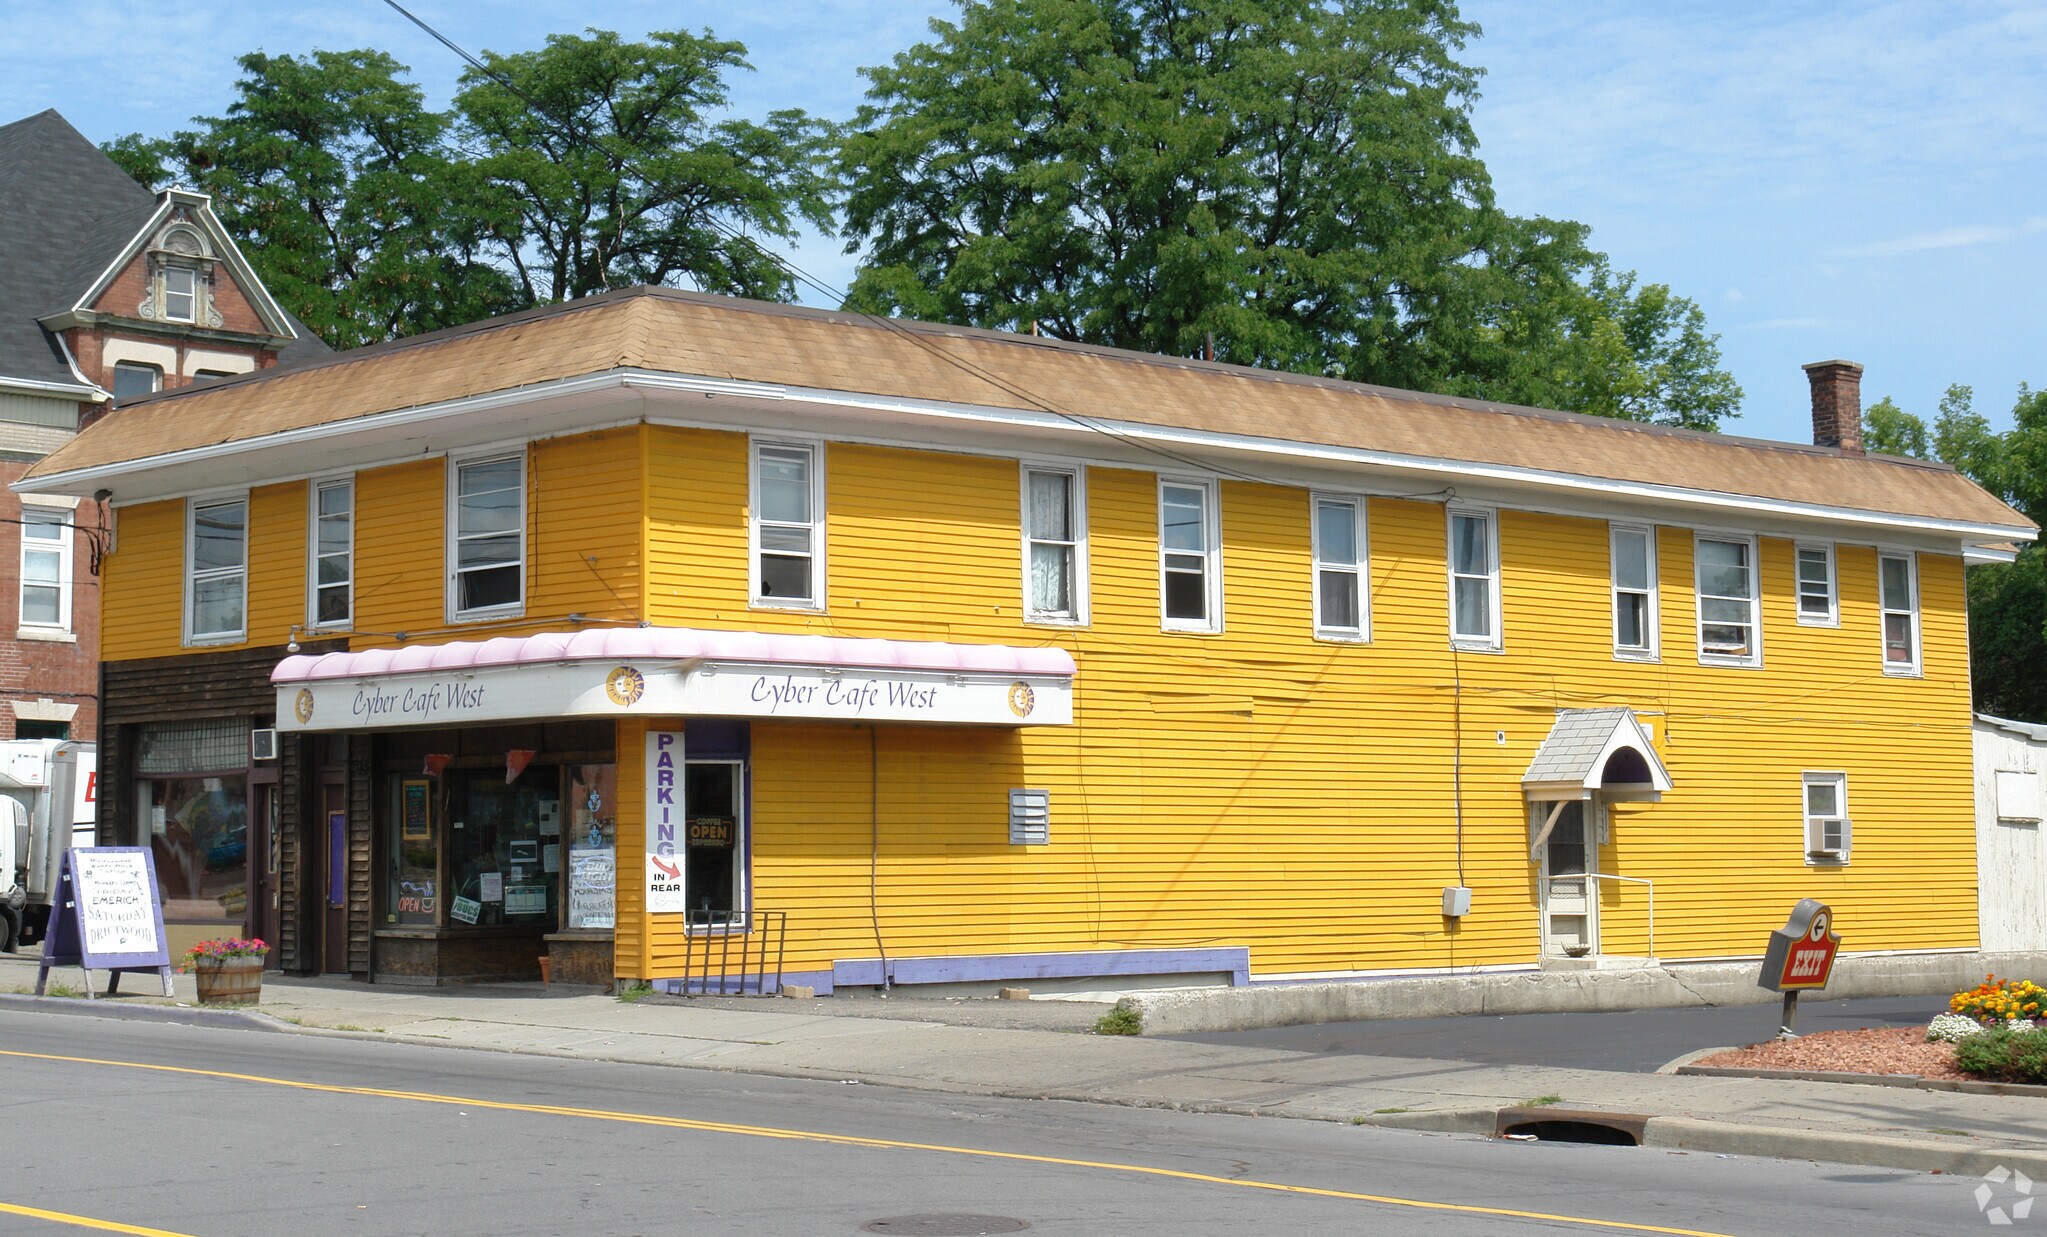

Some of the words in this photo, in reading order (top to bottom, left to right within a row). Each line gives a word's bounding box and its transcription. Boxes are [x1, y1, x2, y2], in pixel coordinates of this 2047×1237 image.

[751, 675, 818, 714] Cyber
[826, 679, 878, 716] Cafe
[888, 681, 938, 708] West
[353, 687, 398, 725] Cyber
[402, 683, 440, 720] Cafe
[447, 683, 485, 709] West
[657, 734, 674, 859] PARKING
[696, 818, 721, 826] COFFEE
[690, 825, 727, 839] OPEN
[654, 873, 665, 881] IN
[651, 884, 681, 892] REAR
[93, 896, 139, 905] EMERICK
[398, 897, 419, 912] OPEN
[88, 905, 146, 921] SATURDAY
[90, 925, 152, 944] DRIFTWOOD
[1790, 950, 1827, 976] EXIT
